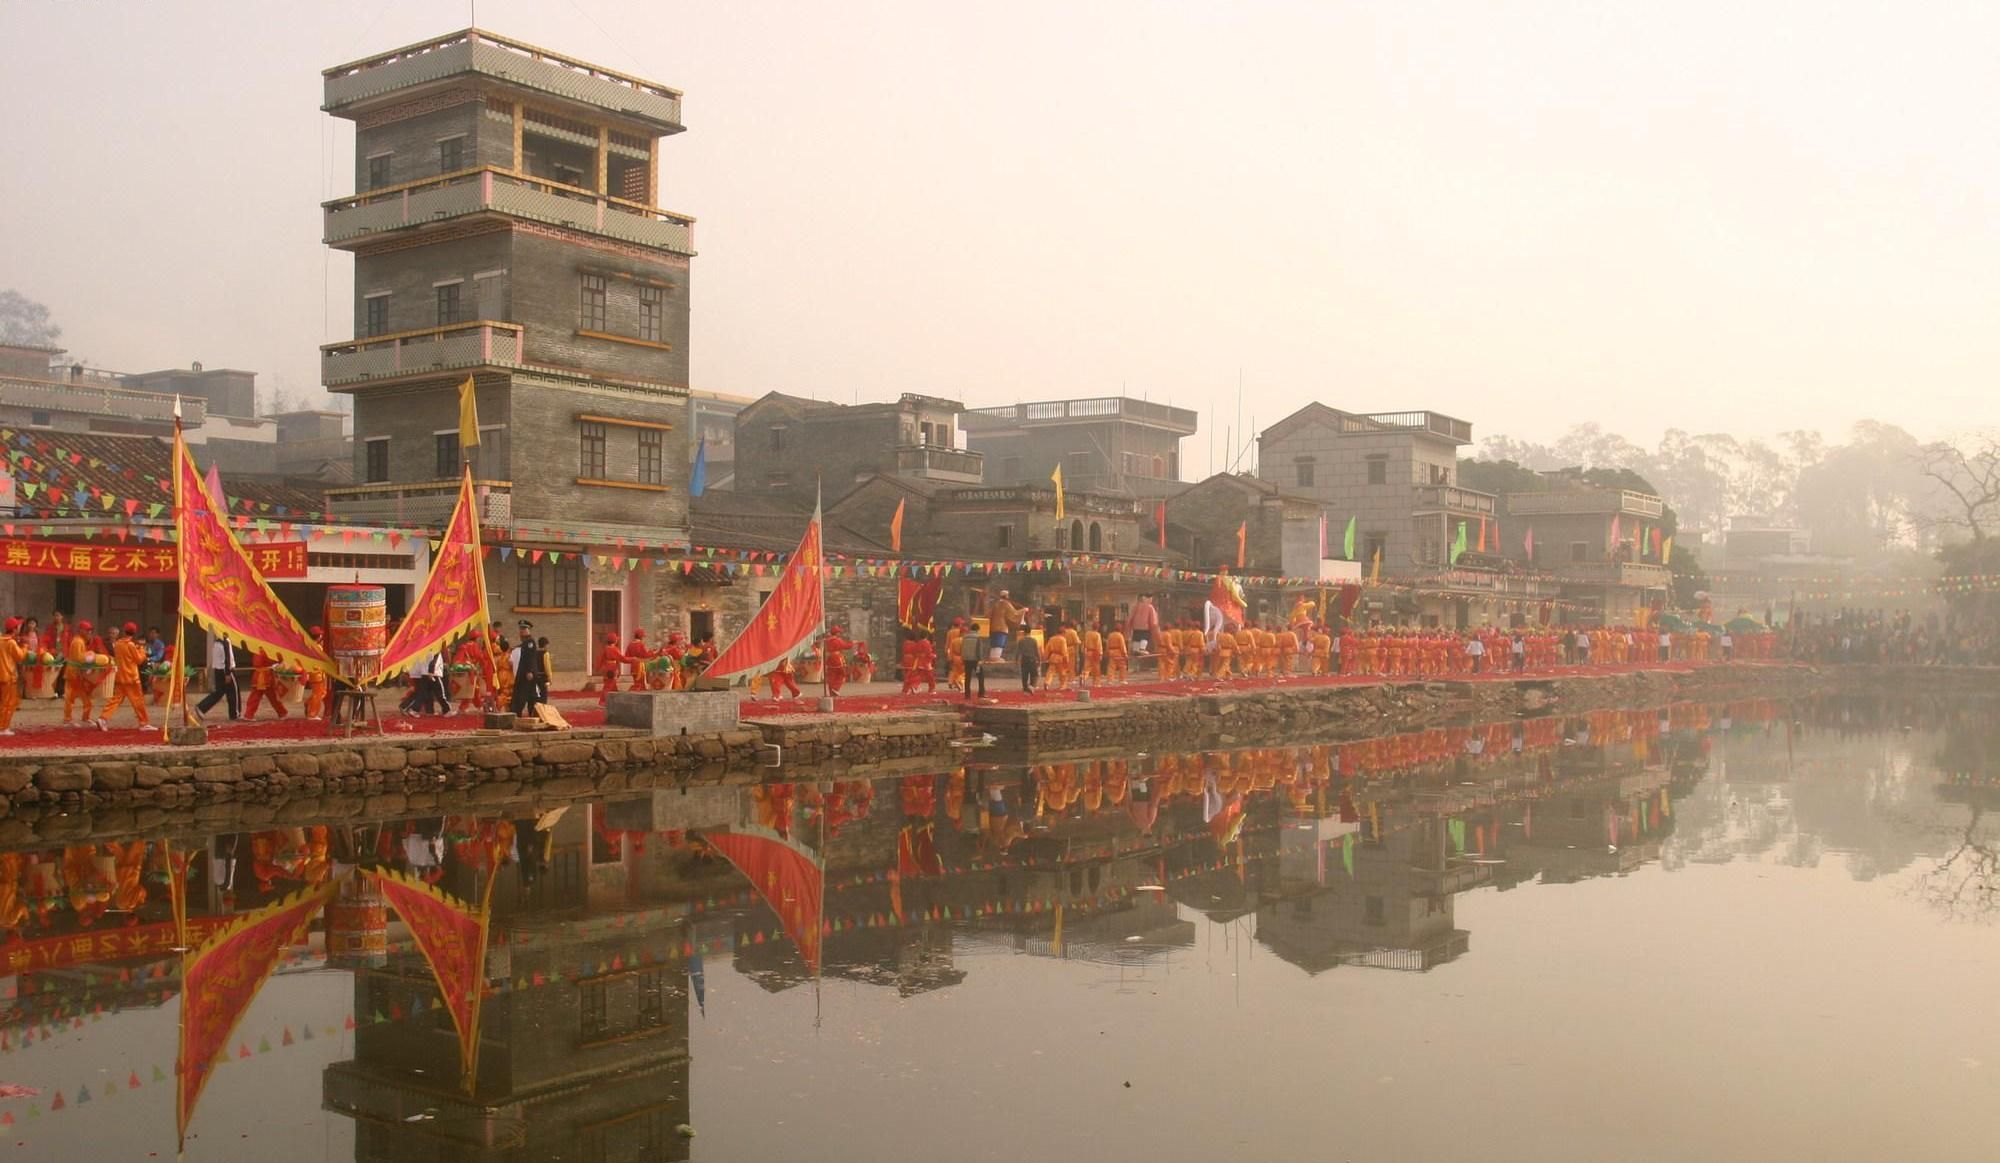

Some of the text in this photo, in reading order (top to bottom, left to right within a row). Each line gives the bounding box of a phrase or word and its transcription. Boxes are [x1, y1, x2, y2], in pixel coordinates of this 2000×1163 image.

[6, 542, 174, 572] 第八届艺术节
